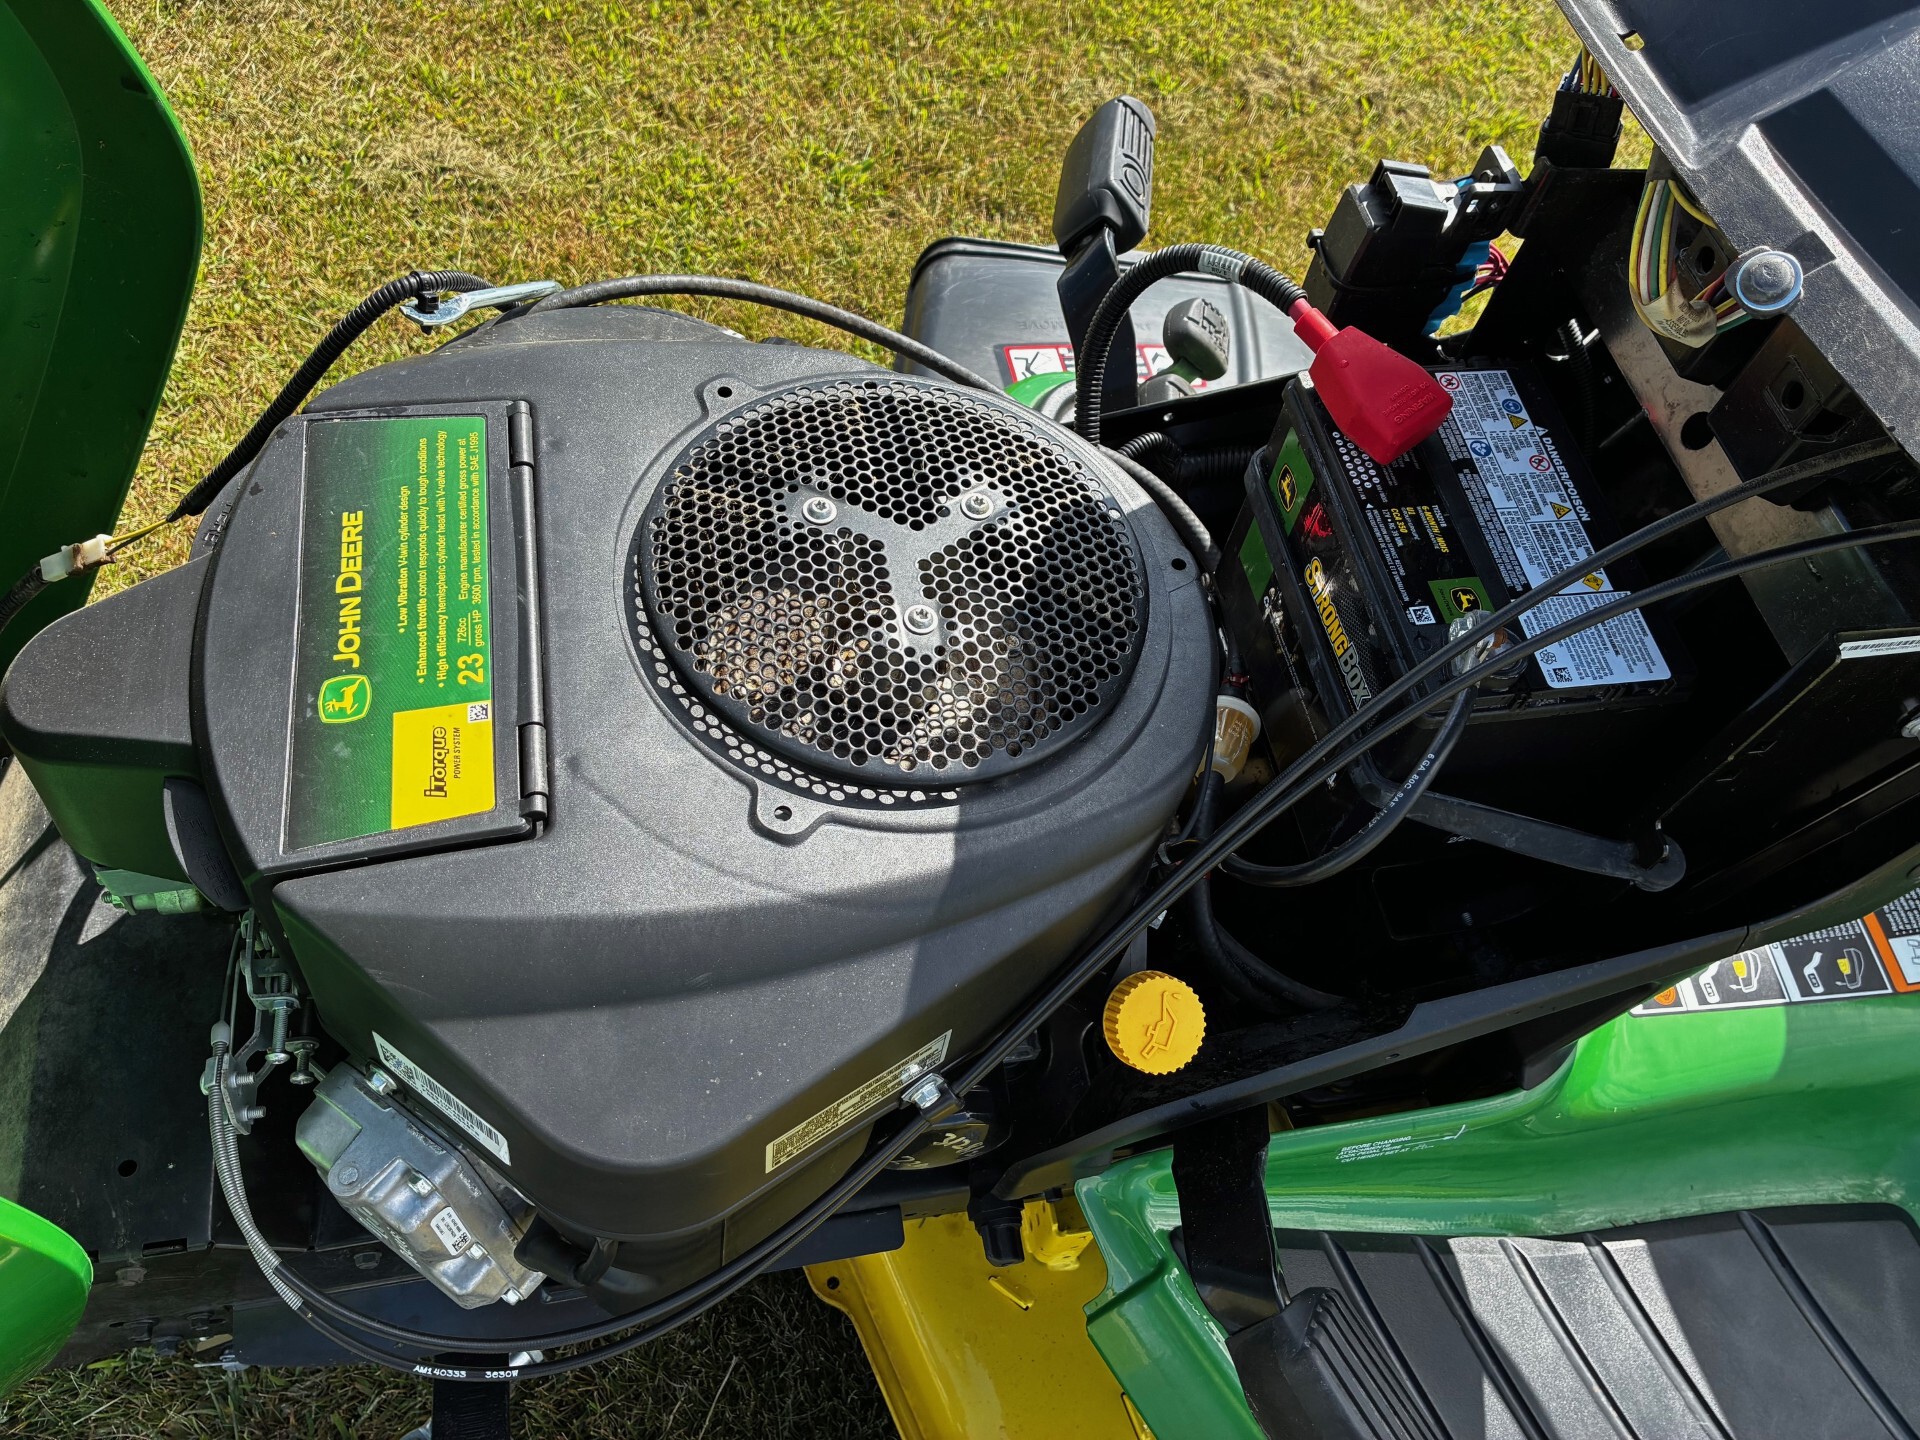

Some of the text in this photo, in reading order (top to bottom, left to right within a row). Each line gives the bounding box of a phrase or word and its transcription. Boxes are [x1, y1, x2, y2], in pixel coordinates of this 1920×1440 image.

[1394, 391, 1436, 424] WARNING
[1541, 436, 1592, 521] DANGER/POISON
[458, 437, 470, 599] Engine manufacturer certified gross power at
[469, 431, 484, 604] 3600 rpm, tested in accordance with SAE J1995
[1381, 509, 1390, 518] 12V
[1389, 508, 1408, 533] CCA 350
[1420, 506, 1440, 532] 6-MONTH
[1435, 537, 1449, 552] MOIS
[397, 485, 410, 626] Low Vibration V-twin cylinder design
[417, 437, 429, 676] Enhanced throttle control responds quickly to tough conditions
[436, 430, 449, 679] High efficiency hemispheric cylinder head with V-valve technology
[1559, 531, 1574, 550] MEDICAL
[1386, 543, 1398, 558] SERVICE
[1393, 559, 1406, 575] RECORD
[332, 510, 363, 667] JOHN DEERE
[456, 617, 467, 642] 726cc
[472, 609, 484, 646] gross HP
[1304, 555, 1371, 710] STRONGBOX
[457, 652, 484, 685] 23
[423, 725, 449, 797] iTorque
[452, 754, 460, 778] POWER
[1417, 760, 1430, 771] GA
[1335, 1144, 1403, 1160] LOCK PEDAL HERE
[1341, 1136, 1412, 1152] BEFORE CHANGING
[1356, 1152, 1384, 1161] HEIGHT
